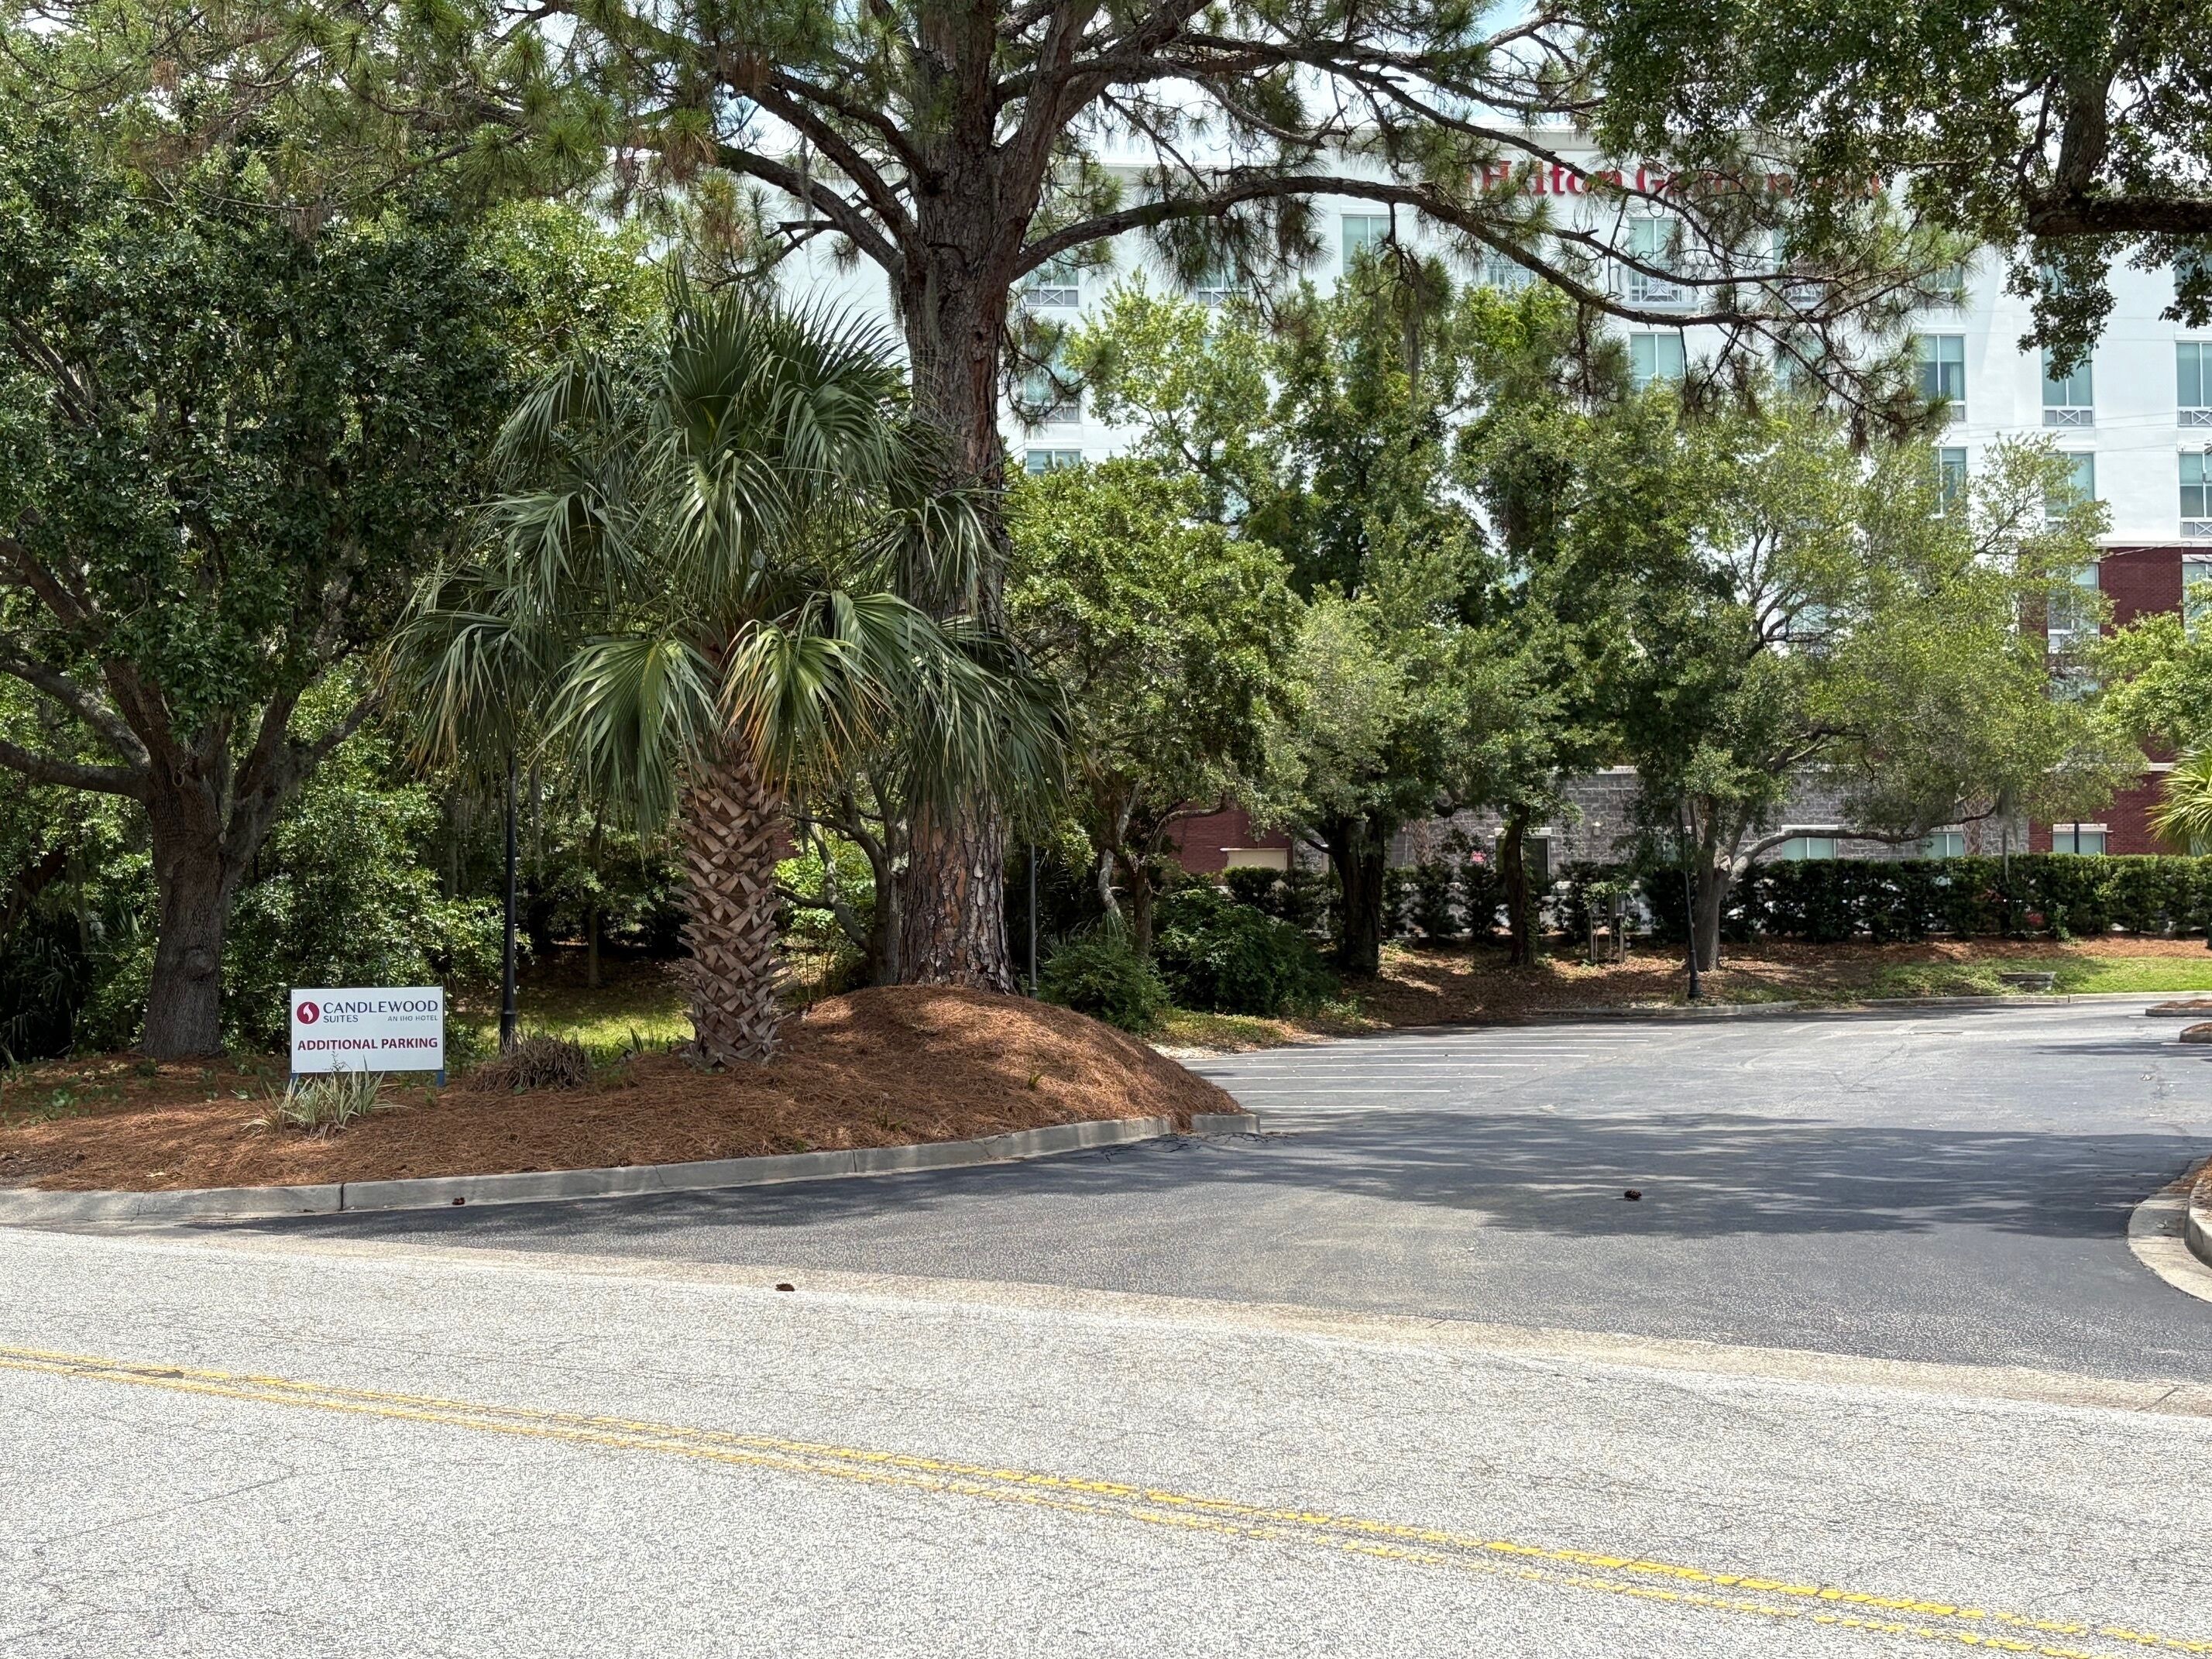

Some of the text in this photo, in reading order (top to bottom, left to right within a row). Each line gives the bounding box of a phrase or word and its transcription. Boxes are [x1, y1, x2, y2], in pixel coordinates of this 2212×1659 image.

[323, 1000, 438, 1014] CANDLEWOOD
[323, 1015, 359, 1023] SUITES
[297, 1038, 438, 1051] ADDITIONAL PARKING
